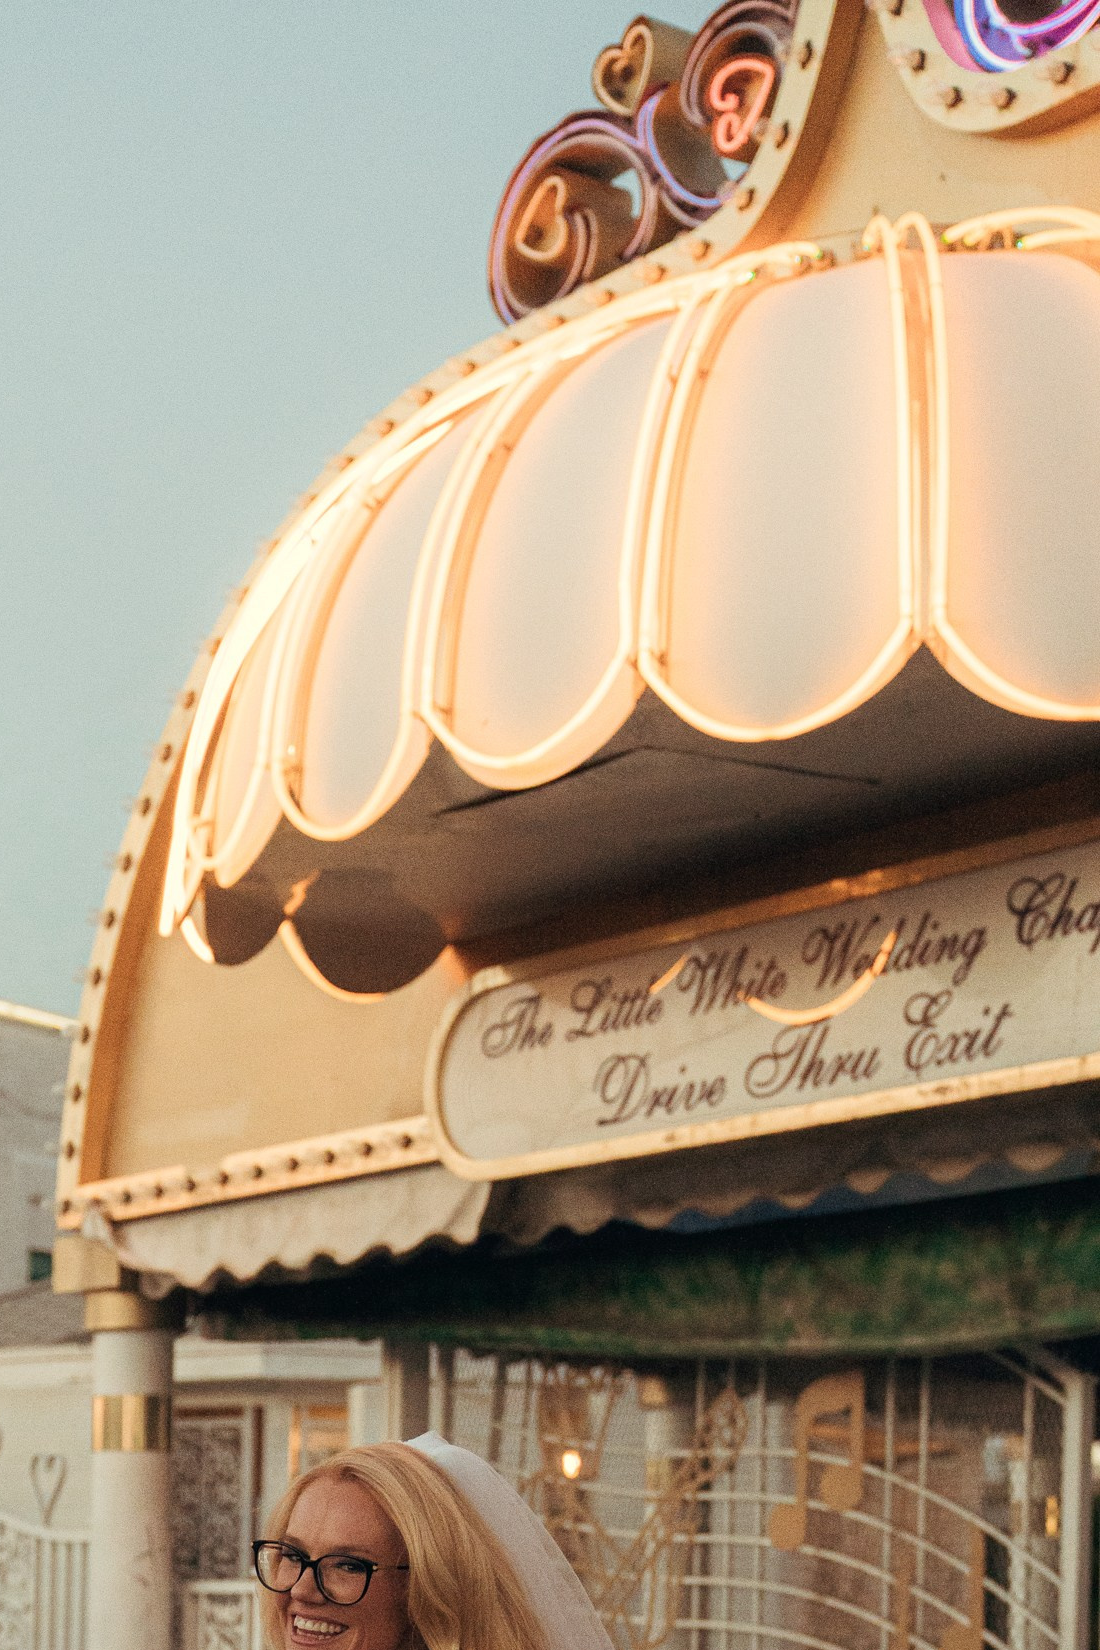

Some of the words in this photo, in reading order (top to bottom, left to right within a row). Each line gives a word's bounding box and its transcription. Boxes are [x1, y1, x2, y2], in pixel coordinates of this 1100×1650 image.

[482, 993, 553, 1059] The
[565, 978, 664, 1043] Little
[679, 945, 788, 1015] White
[803, 911, 987, 988] Wedding
[593, 1052, 727, 1127] Drive
[745, 1016, 880, 1100] Thru
[903, 988, 1012, 1075] Exit
